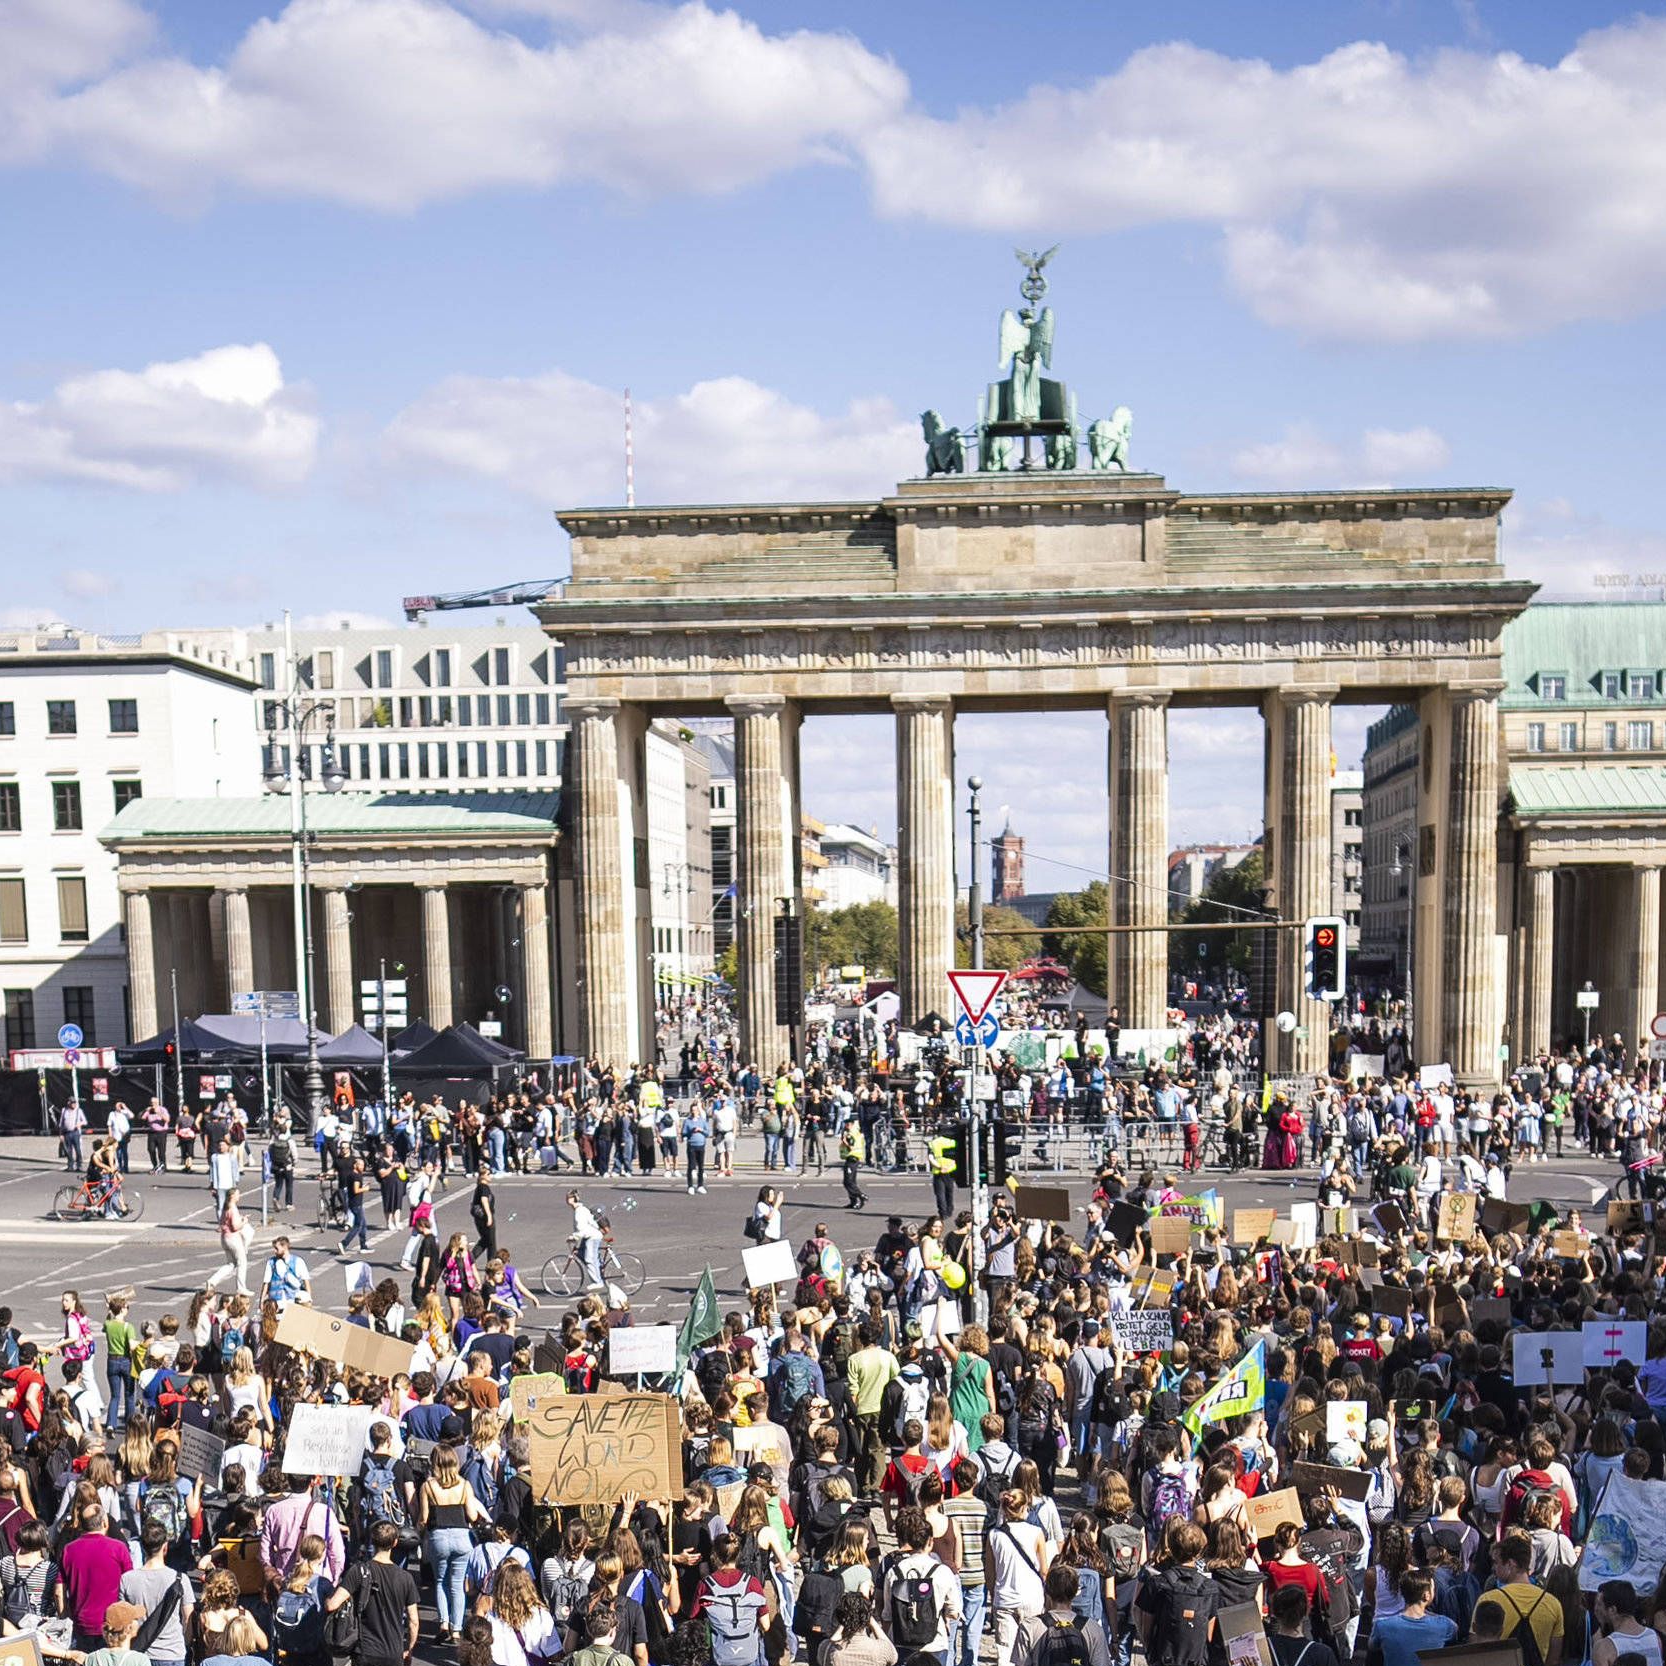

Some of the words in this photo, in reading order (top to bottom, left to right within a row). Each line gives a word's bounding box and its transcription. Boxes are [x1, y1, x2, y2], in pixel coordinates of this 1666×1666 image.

[1123, 1340, 1166, 1351] LEBEN
[532, 1400, 621, 1440] SAVE
[618, 1397, 664, 1431] THE
[558, 1433, 655, 1469] WORLD
[542, 1465, 657, 1502] NOW
